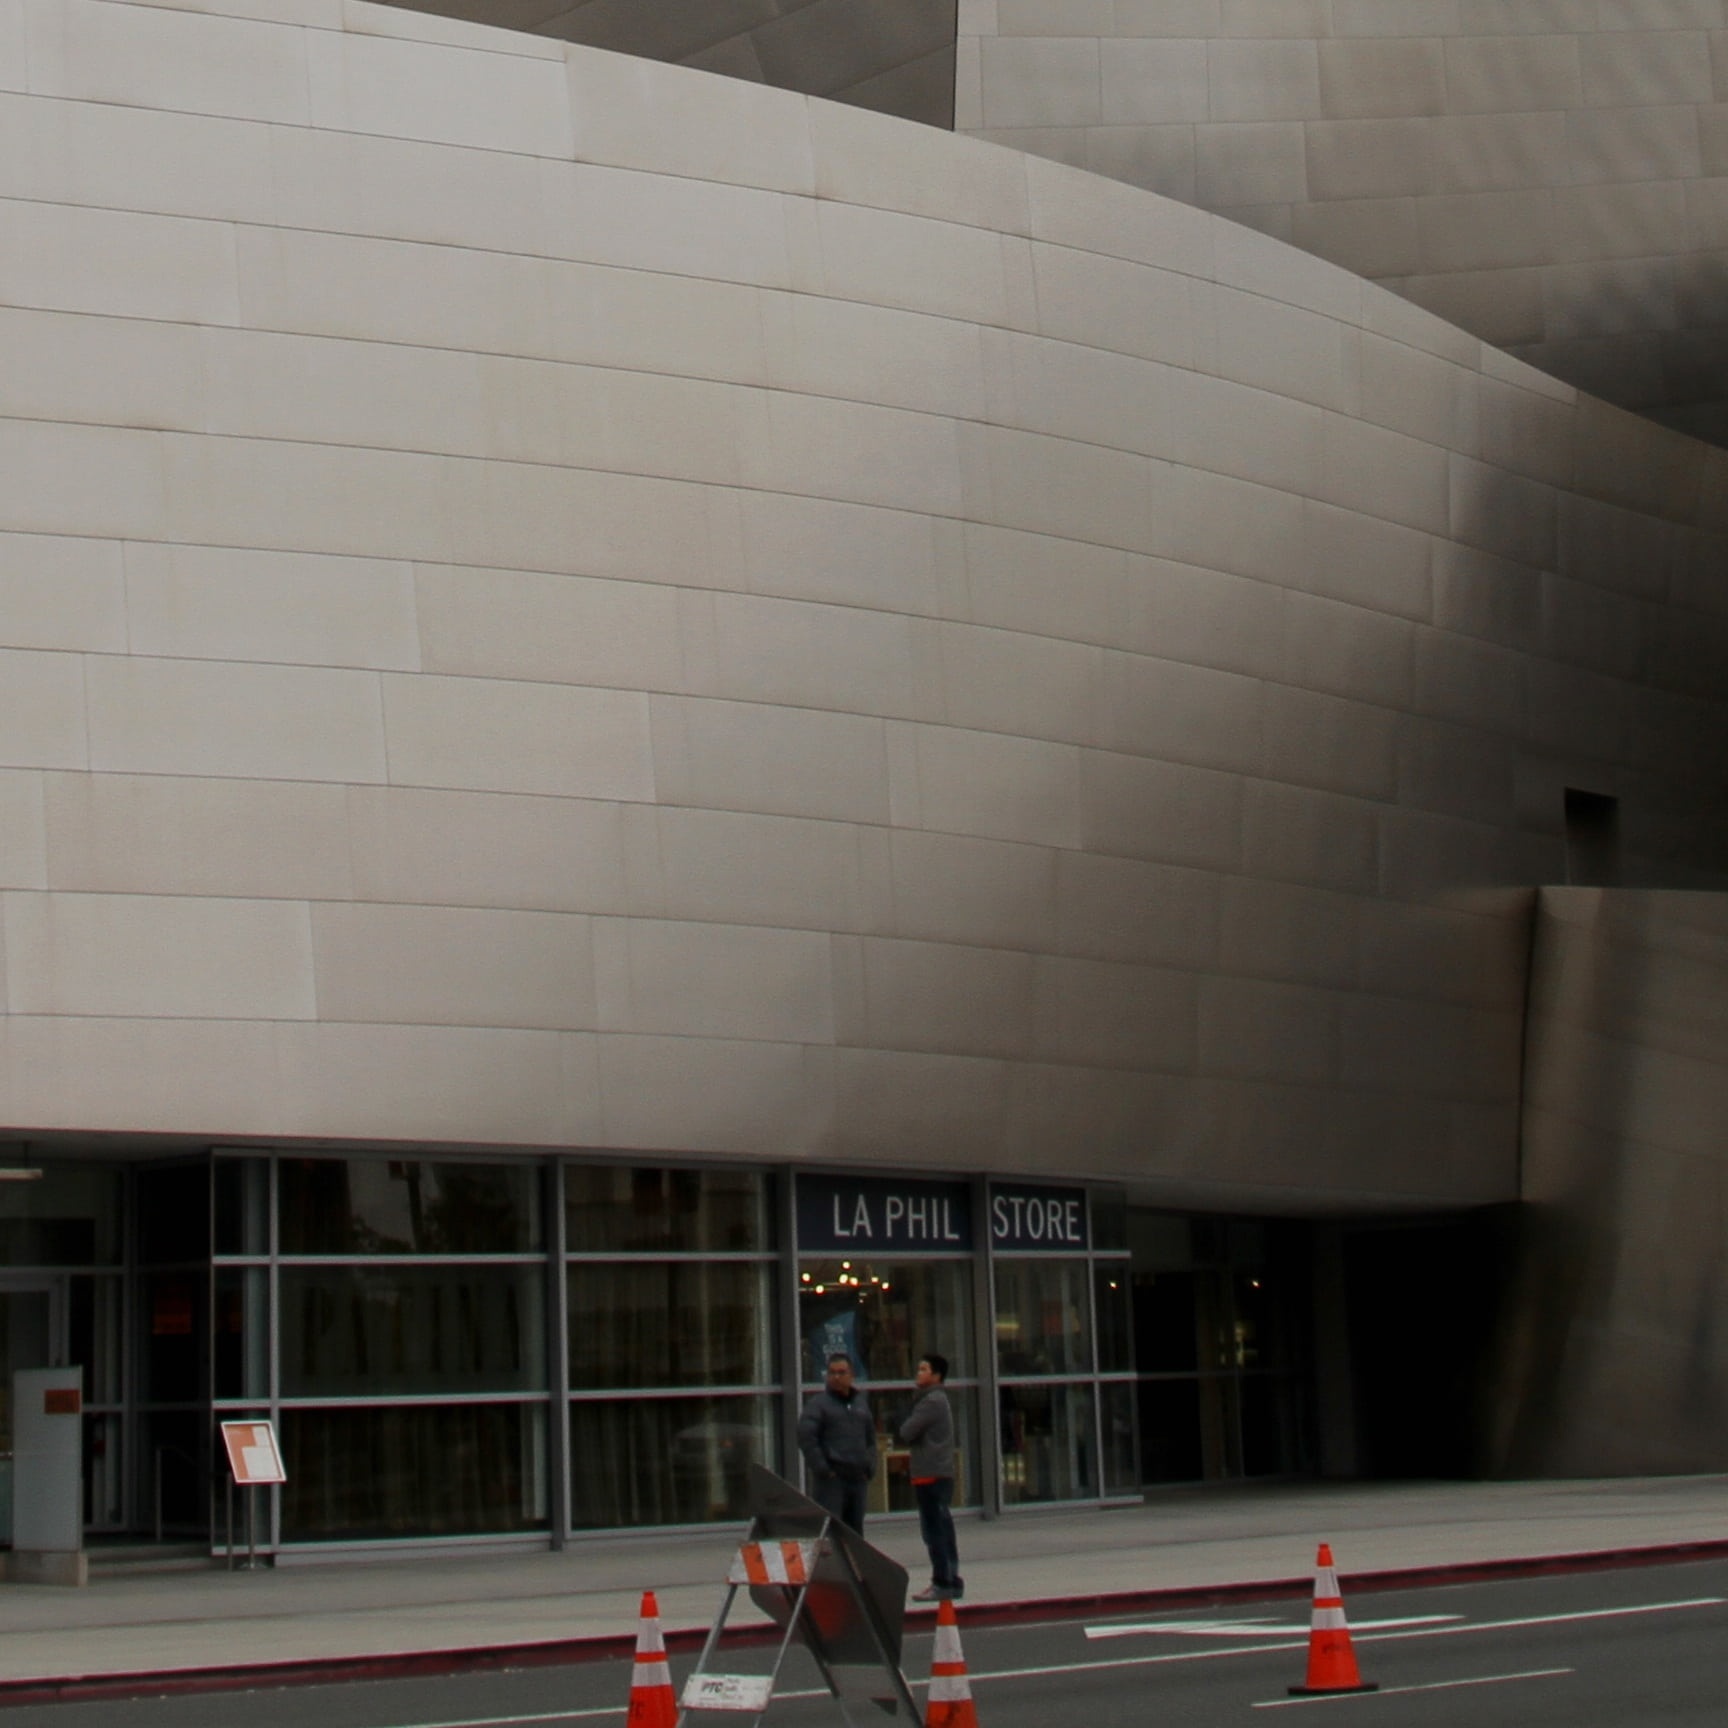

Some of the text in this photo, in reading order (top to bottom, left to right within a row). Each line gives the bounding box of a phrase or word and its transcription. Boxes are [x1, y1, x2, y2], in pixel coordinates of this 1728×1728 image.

[833, 1193, 1082, 1241] LA PHIL STORE
